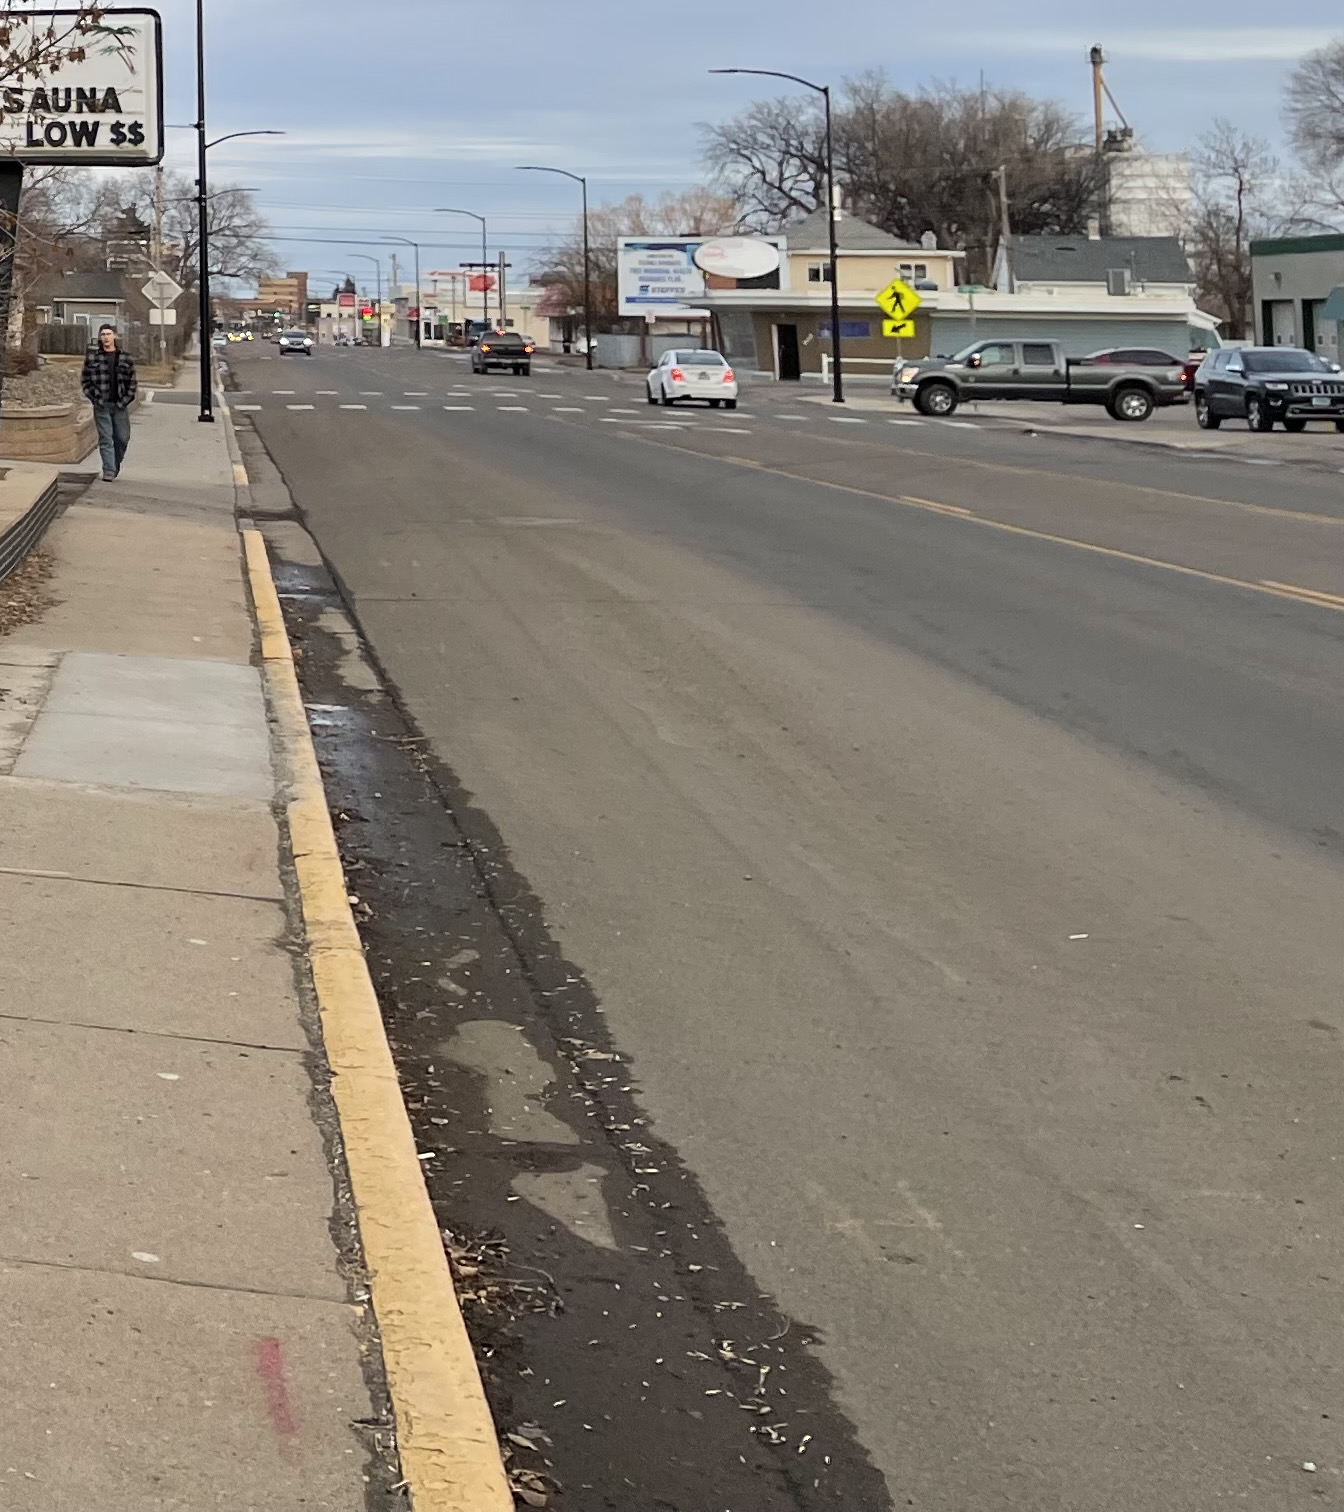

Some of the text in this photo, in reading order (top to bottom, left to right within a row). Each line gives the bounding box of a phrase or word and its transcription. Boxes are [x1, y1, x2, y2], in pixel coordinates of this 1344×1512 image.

[3, 86, 122, 114] SAUNA
[26, 120, 146, 147] LOW $$
